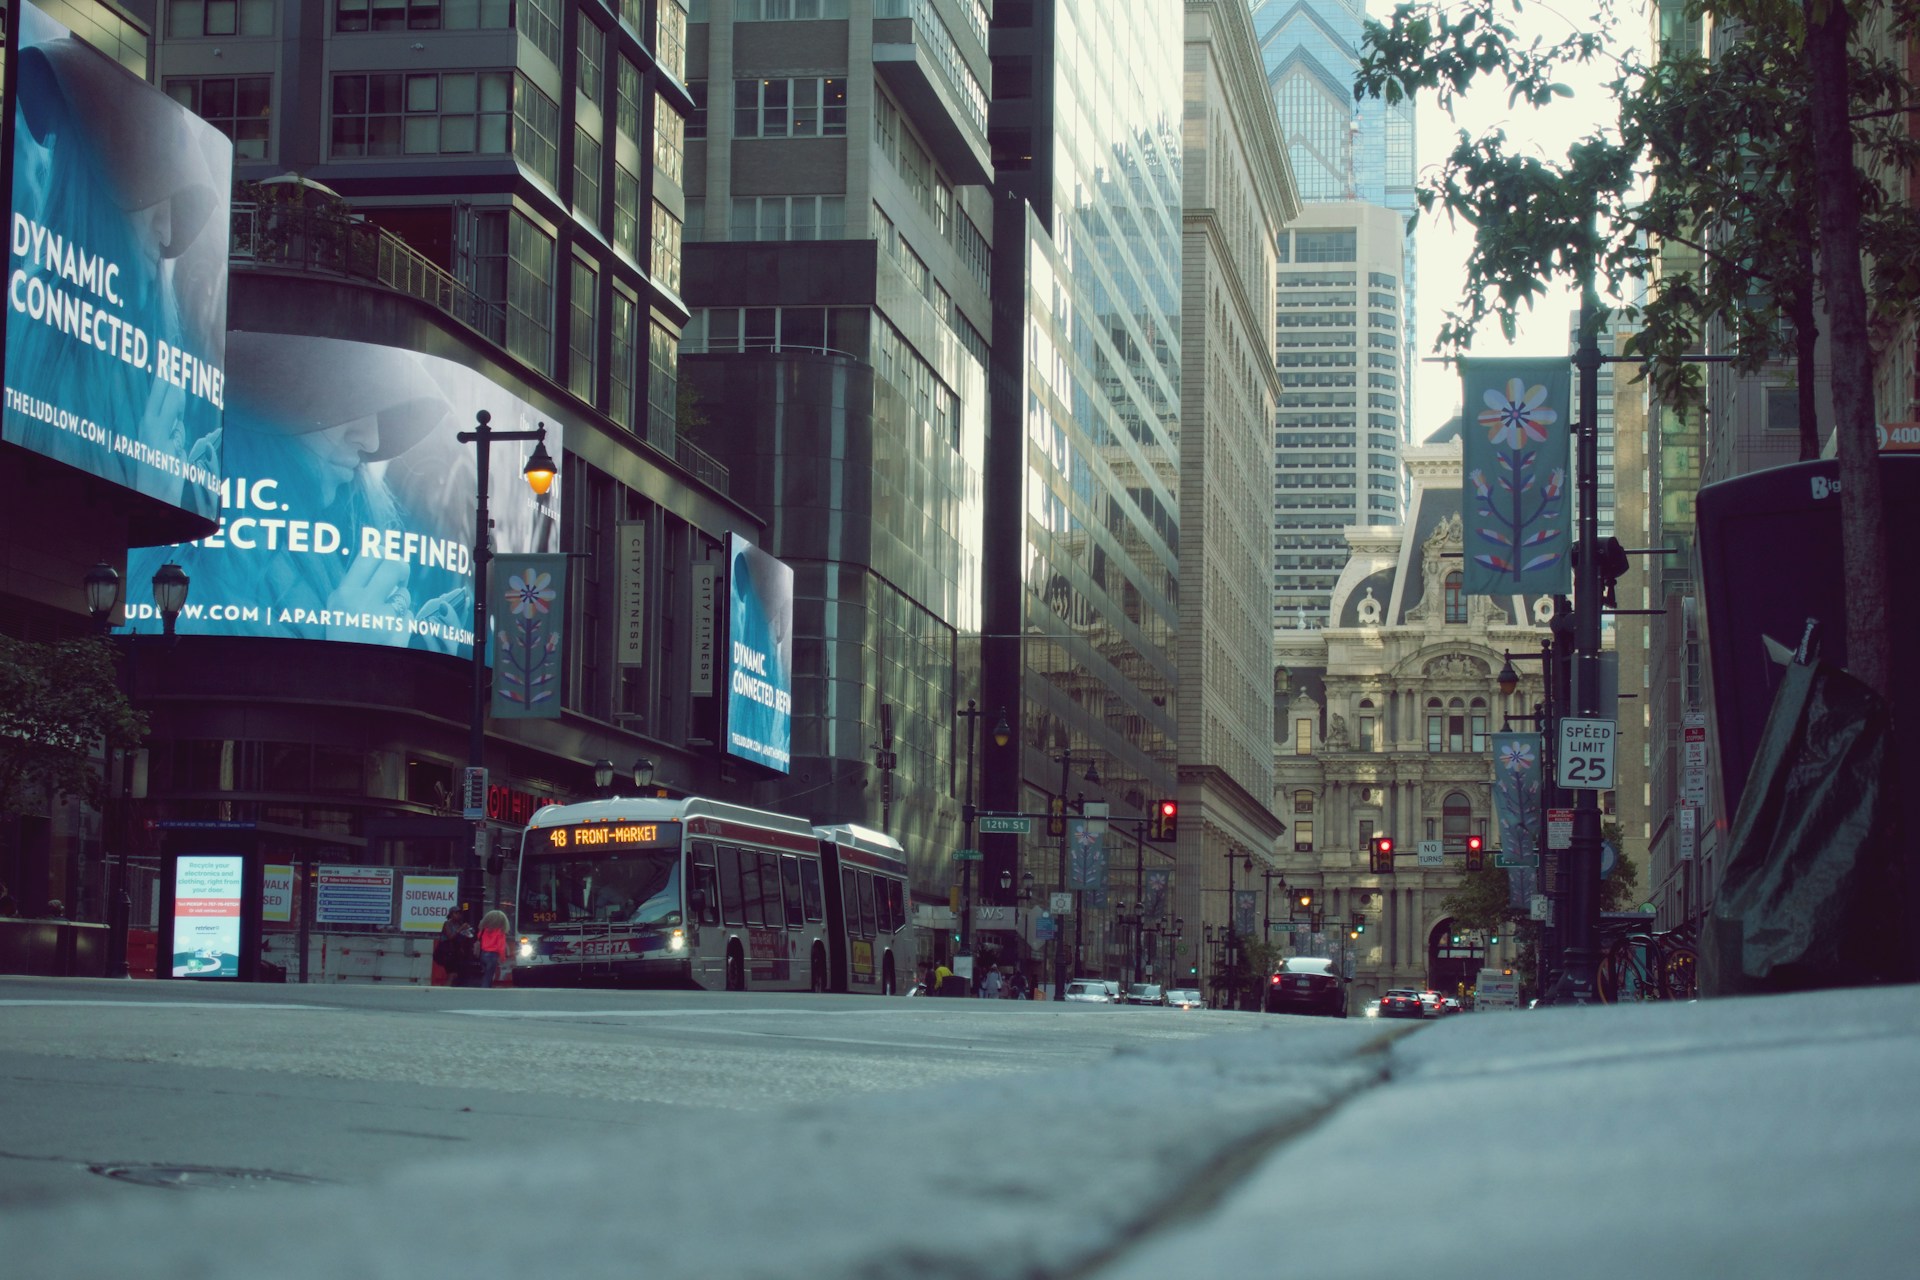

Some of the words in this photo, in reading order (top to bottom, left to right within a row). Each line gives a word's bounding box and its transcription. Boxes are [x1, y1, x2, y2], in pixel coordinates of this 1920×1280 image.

[13, 212, 124, 308] DYNAMIC.
[11, 269, 152, 374] CONNECTED.
[6, 386, 105, 446] THELUDLOW.COM
[114, 433, 180, 477] APARTMENTS
[182, 462, 208, 486] NOW
[361, 526, 473, 577] REFINED.
[631, 538, 641, 575] CITY
[702, 577, 711, 611] CITY
[279, 607, 403, 632] APARTMENTS
[408, 619, 440, 637] NOW
[629, 582, 641, 650] FITNESS
[700, 617, 711, 681] FITNESS
[734, 640, 767, 677] DYNAMIC.
[733, 669, 775, 709] CONNECTED.
[1566, 727, 1611, 739] SPEED
[1570, 741, 1606, 753] LIMIT
[1568, 756, 1606, 782] 25
[550, 829, 568, 848] 48
[575, 825, 657, 845] FRONT-MARKET
[986, 820, 1008, 829] 12th
[1013, 821, 1024, 829] St
[1424, 844, 1436, 852] NO
[405, 890, 455, 901] SIDEWALK
[410, 906, 448, 917] CLOSED
